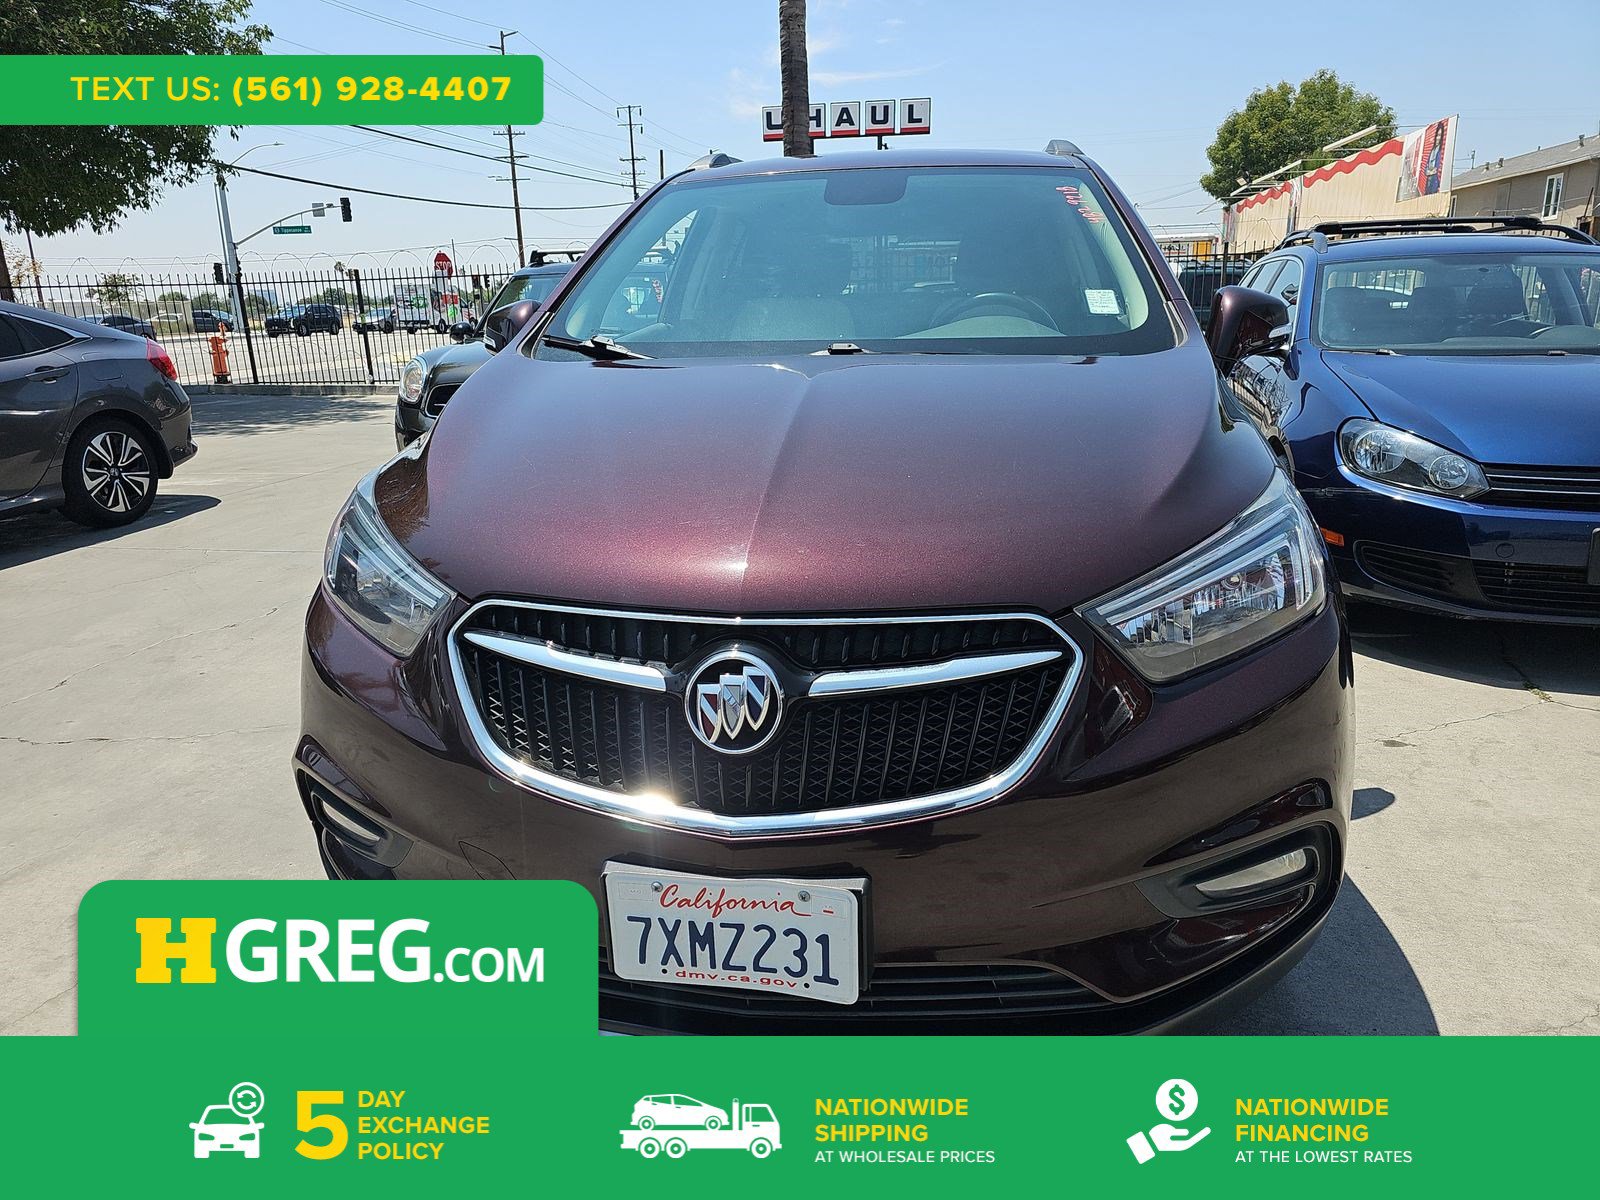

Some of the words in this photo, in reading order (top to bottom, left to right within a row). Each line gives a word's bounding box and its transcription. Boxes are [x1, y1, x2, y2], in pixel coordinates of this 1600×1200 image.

[435, 261, 451, 270] STOP
[659, 884, 812, 918] California
[627, 916, 839, 986] 7XMZ231
[675, 970, 797, 989] dmv.ca.gov
